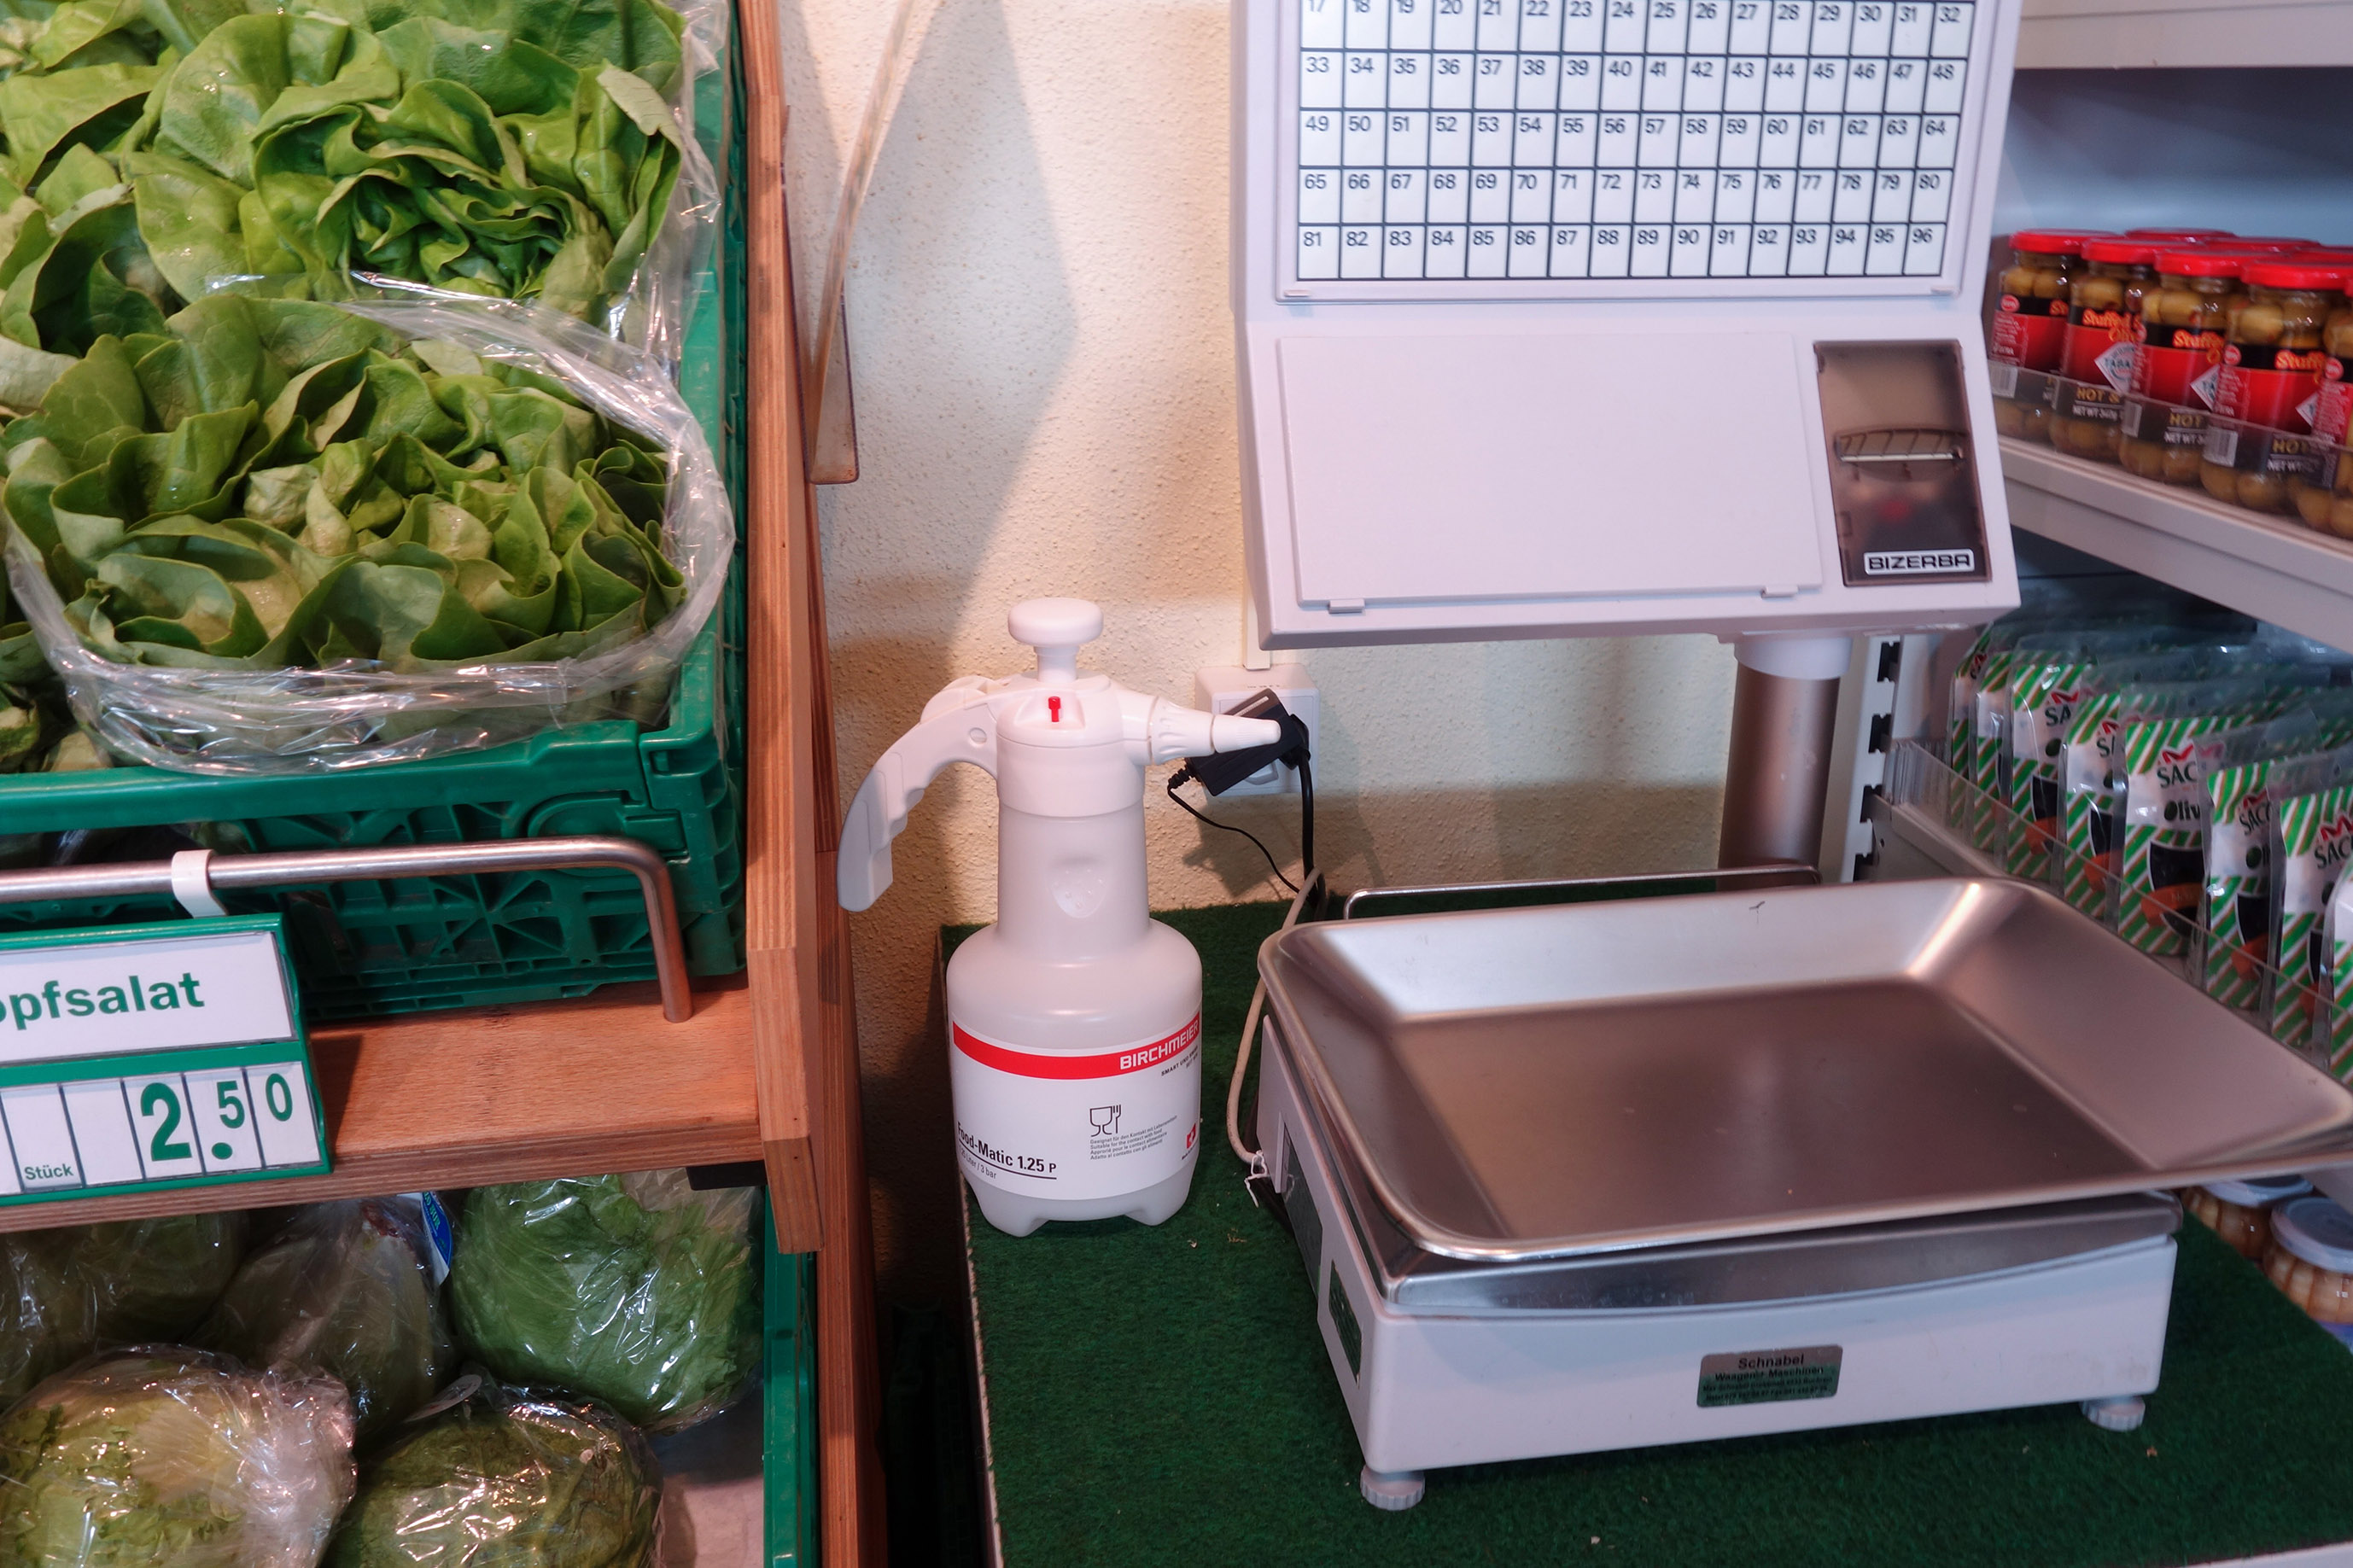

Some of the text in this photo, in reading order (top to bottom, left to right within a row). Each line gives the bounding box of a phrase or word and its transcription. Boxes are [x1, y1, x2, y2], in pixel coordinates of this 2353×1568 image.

[1309, 0, 1960, 23] 17 18 19 20 21 22 23 24 25 26 27 28 29 30 31 32
[1306, 56, 1955, 80] 33 34 35 36 37 38 39 40 41 42 43 44 45 46 47 48
[1305, 115, 1947, 136] 49 50 51 52 53 54 55 56 57 58 59 60 61 62 63 64
[1304, 172, 1941, 190] 65 66 67 68 69 70 71 72 73 74 75 76 77 78 79 80
[1303, 227, 1933, 248] 81 82 83 84 85 86 87 88 89 90 91 92 93 94 95 96
[2076, 387, 2105, 402] HOT
[2169, 412, 2204, 428] HOT
[1868, 555, 1971, 570] BIZERBA
[1119, 1019, 1199, 1070] BIRCHMEIER
[1161, 1062, 1180, 1076] SMART
[957, 1121, 1057, 1173] Food-Matic 1.25 P
[24, 1163, 74, 1180] Stück
[980, 1164, 985, 1174] 3
[985, 1167, 997, 1179] bar
[1738, 1353, 1804, 1370] Schnabel
